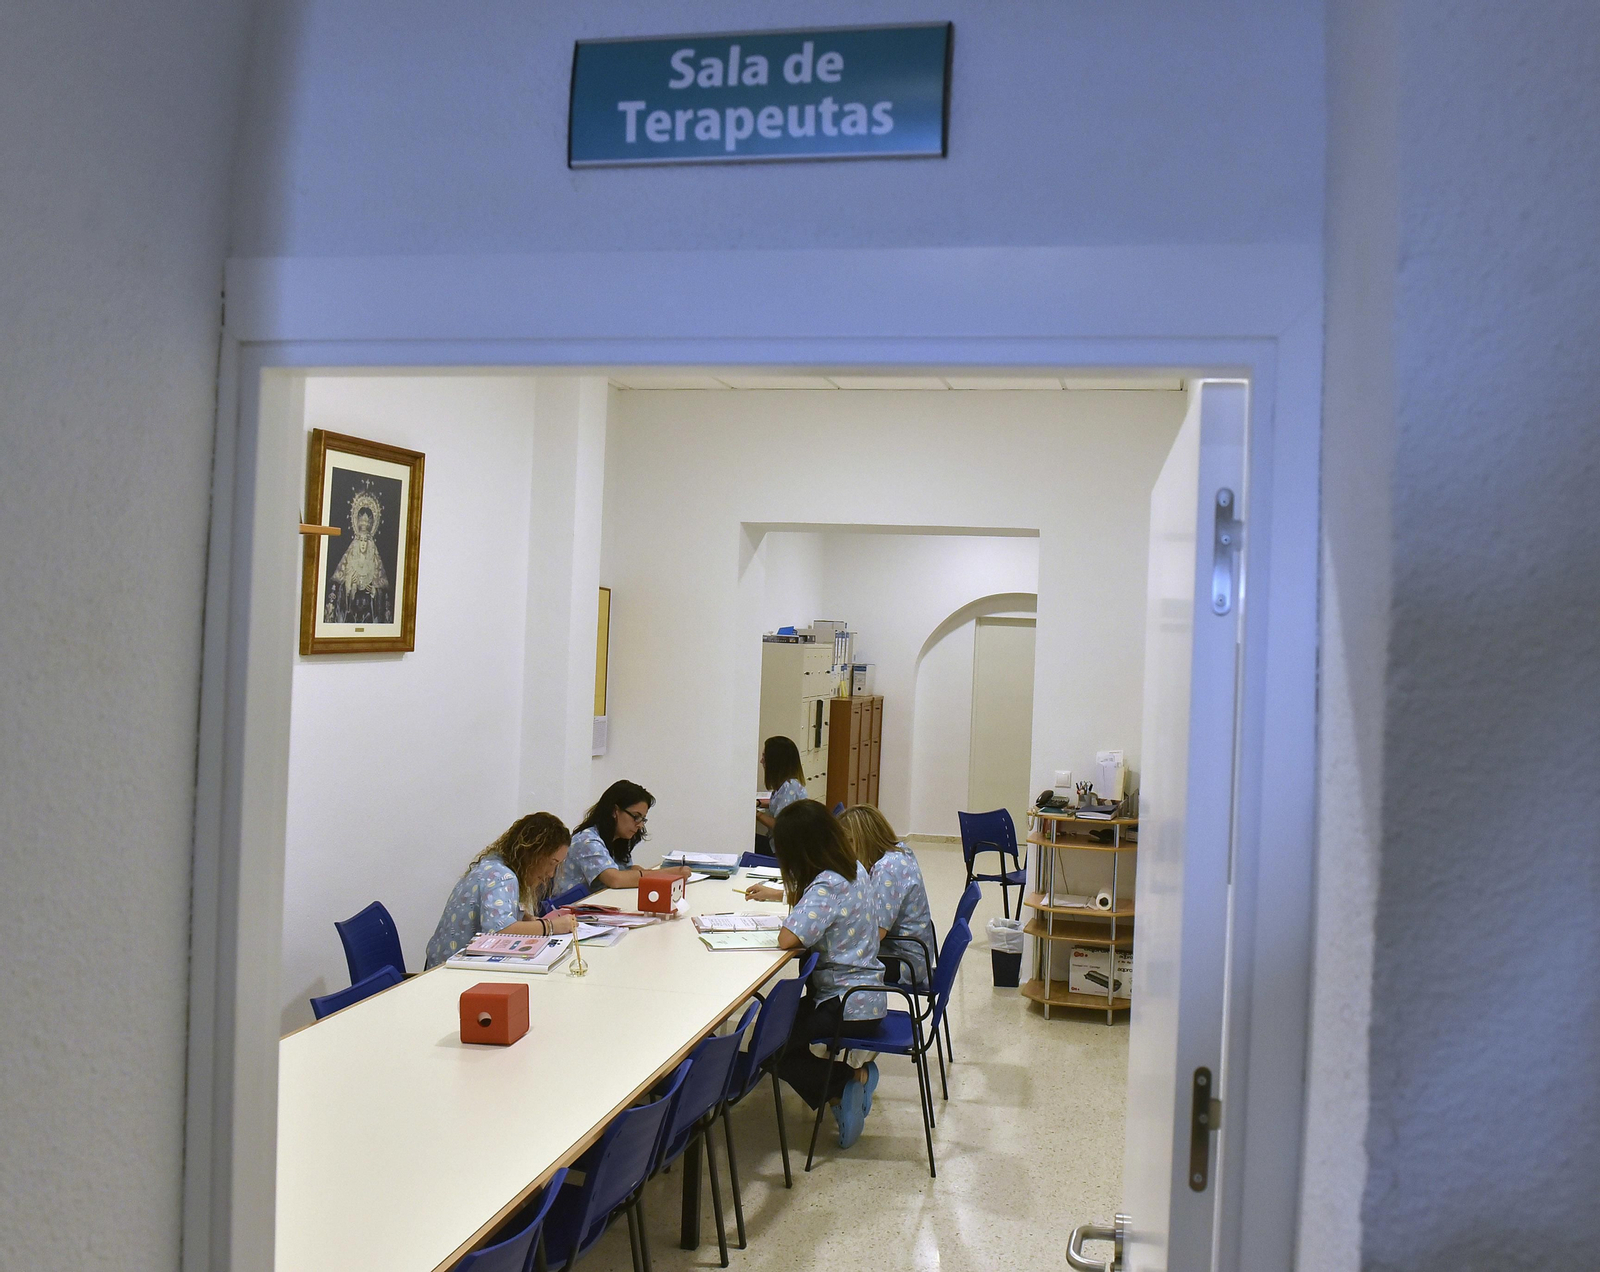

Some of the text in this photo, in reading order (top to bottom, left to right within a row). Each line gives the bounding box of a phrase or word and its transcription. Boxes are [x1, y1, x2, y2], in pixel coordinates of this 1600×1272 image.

[668, 41, 845, 90] Sala de
[617, 97, 895, 152] Terapeutas
